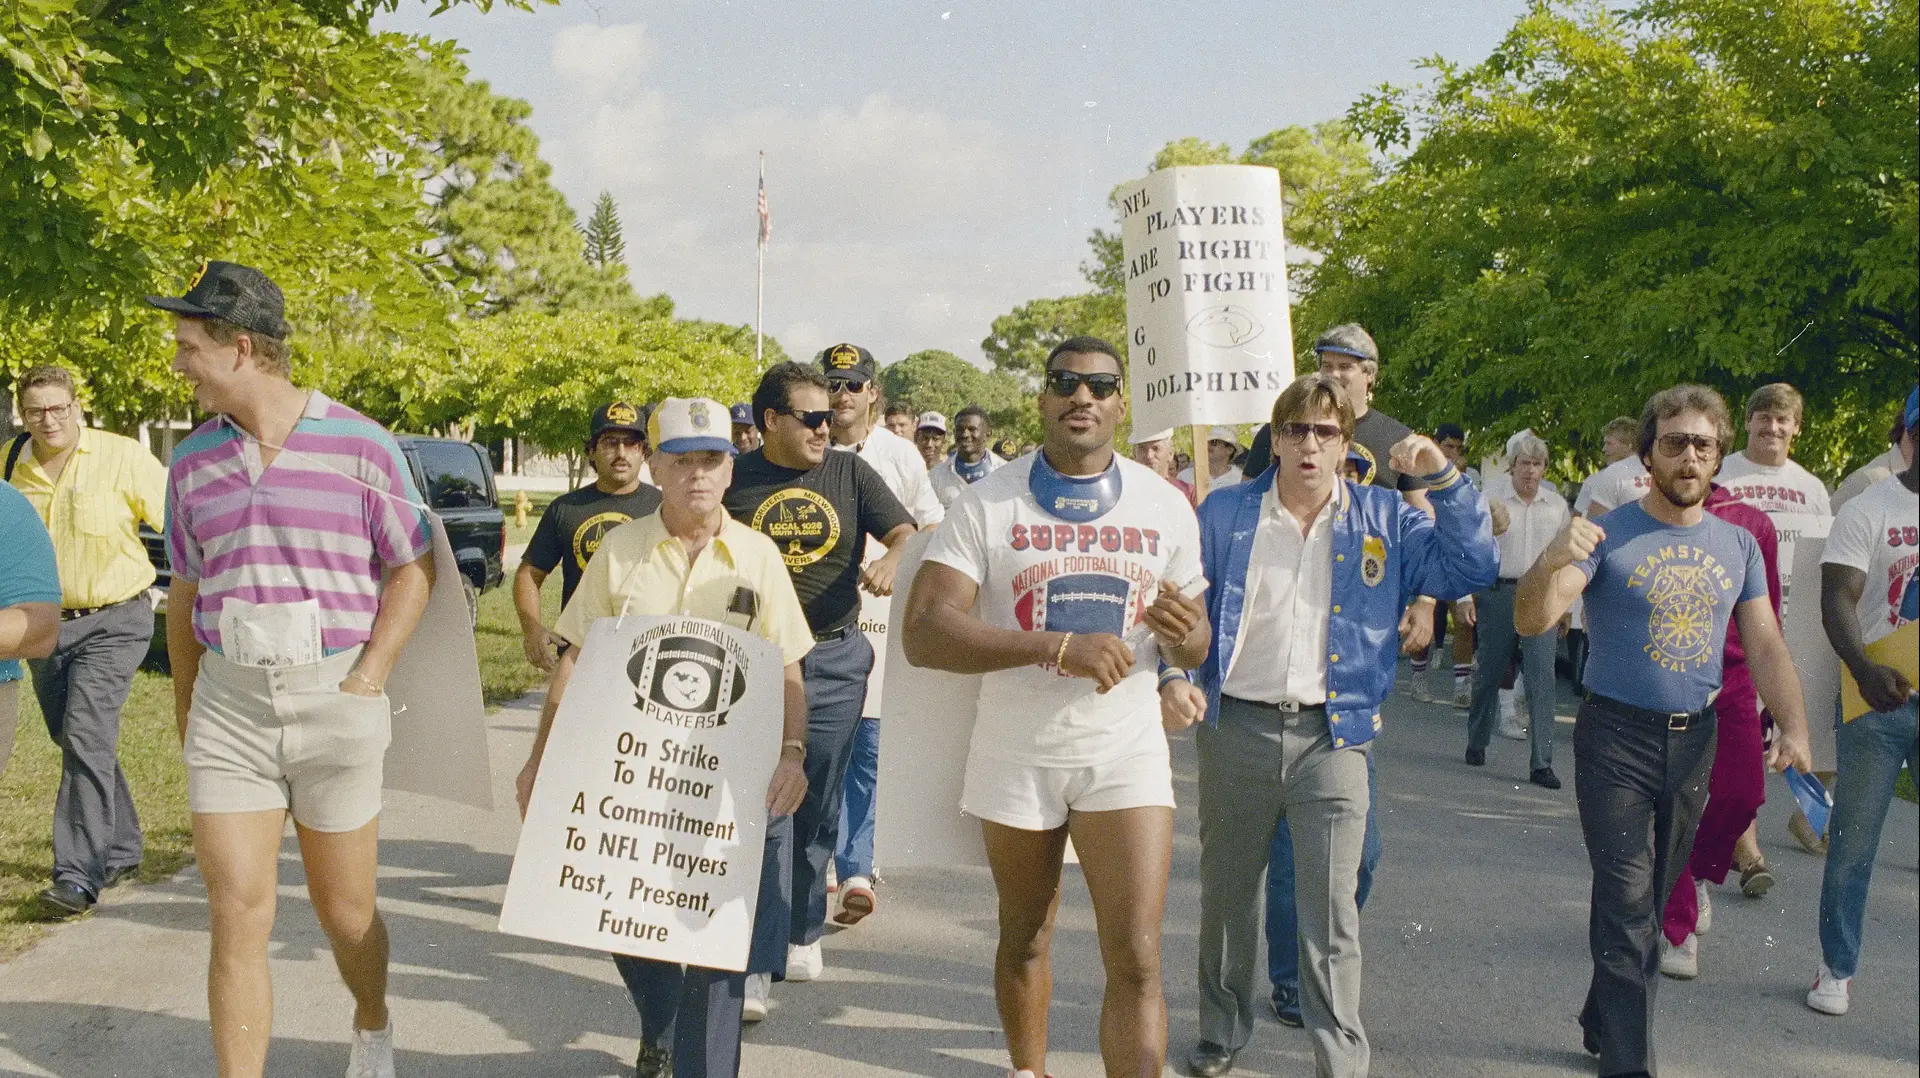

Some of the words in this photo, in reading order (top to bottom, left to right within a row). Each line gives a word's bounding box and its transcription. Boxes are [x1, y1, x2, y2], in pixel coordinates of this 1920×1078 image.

[1122, 188, 1150, 218] NFL
[1146, 205, 1265, 234] PLAYERS
[1128, 246, 1158, 280] ARE
[1177, 240, 1271, 260] RIGHT
[1147, 278, 1171, 304] TO
[1184, 271, 1276, 292] FIGHT
[1146, 370, 1281, 402] DOLPHINS
[1733, 485, 1806, 505] SUPPORT
[769, 522, 799, 531] LOCAL
[803, 492, 838, 540] MILLWRIGHTS
[1010, 523, 1161, 557] SUPPORT
[1011, 560, 1060, 600] NATIONAL
[1063, 556, 1120, 575] FOOTBALL
[1626, 544, 1733, 591] TEAMSTERS
[629, 621, 677, 656] NATIONAL
[680, 620, 724, 647] FOOTBALL
[725, 634, 749, 679] LEAGUE
[1643, 644, 1686, 673] LOCAL
[645, 701, 717, 730] PLAYERS
[616, 731, 648, 758] On
[659, 738, 719, 772] Strike
[613, 759, 635, 786] To
[647, 766, 714, 800] Honor
[571, 791, 585, 815] A
[598, 795, 736, 842] Commitment
[565, 826, 587, 852] To
[598, 831, 640, 862] NFL
[651, 843, 728, 878] Players
[558, 864, 614, 901] Past,
[627, 876, 716, 919] Present,
[598, 908, 669, 943] Future
